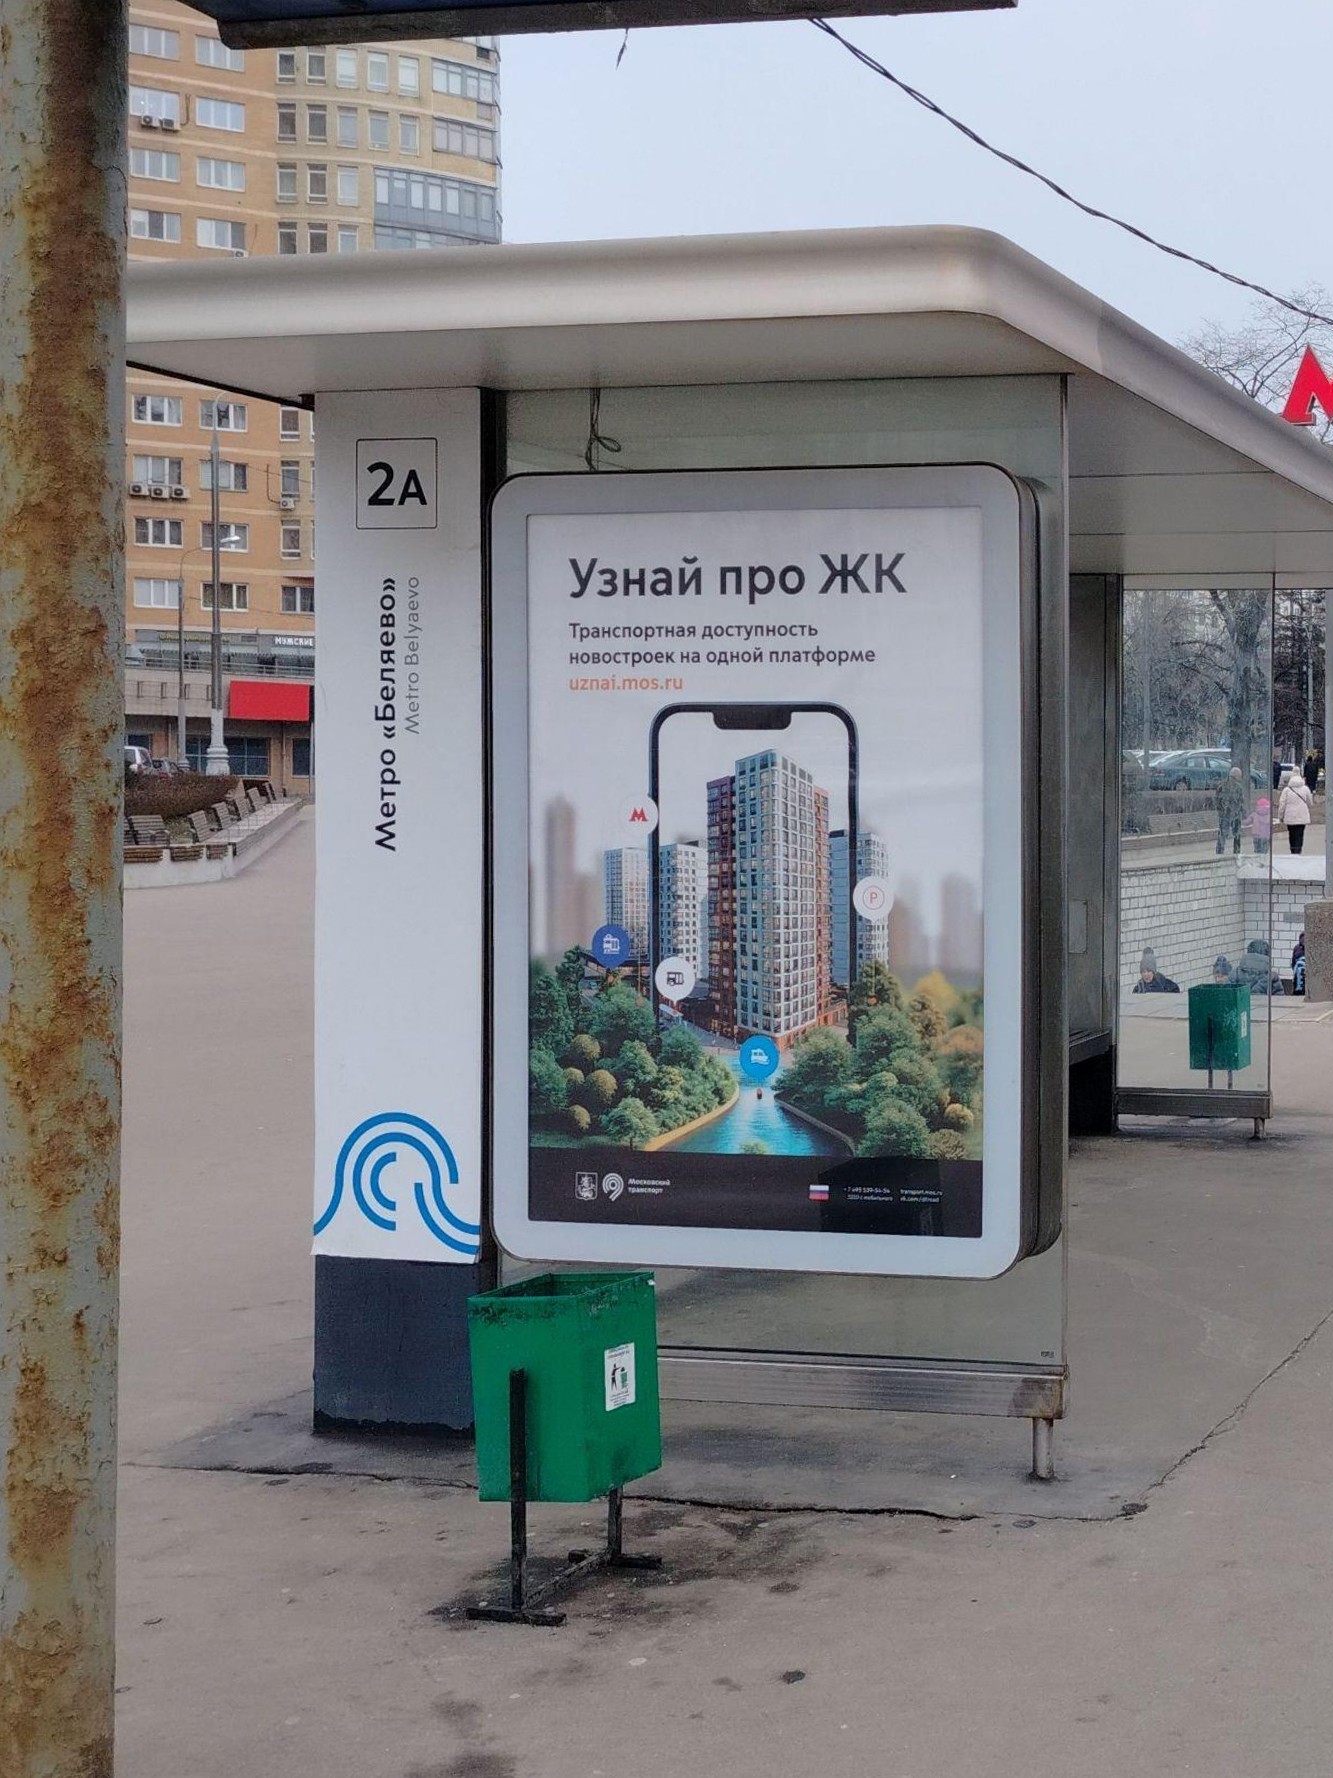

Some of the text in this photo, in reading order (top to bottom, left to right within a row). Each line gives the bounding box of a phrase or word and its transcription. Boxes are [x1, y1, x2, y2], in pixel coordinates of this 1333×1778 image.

[367, 461, 427, 507] 2А
[570, 553, 907, 605] Узнай про ЖК
[569, 622, 819, 642] Транспортная доступность
[404, 576, 423, 735] Metro Belyaevo
[569, 646, 876, 667] новостроек на одной платформе
[569, 675, 684, 691] uznai.mos.ru
[375, 577, 400, 852] Метро «Беляево»
[628, 1178, 671, 1186] Московский
[628, 1187, 664, 1195] транспорт
